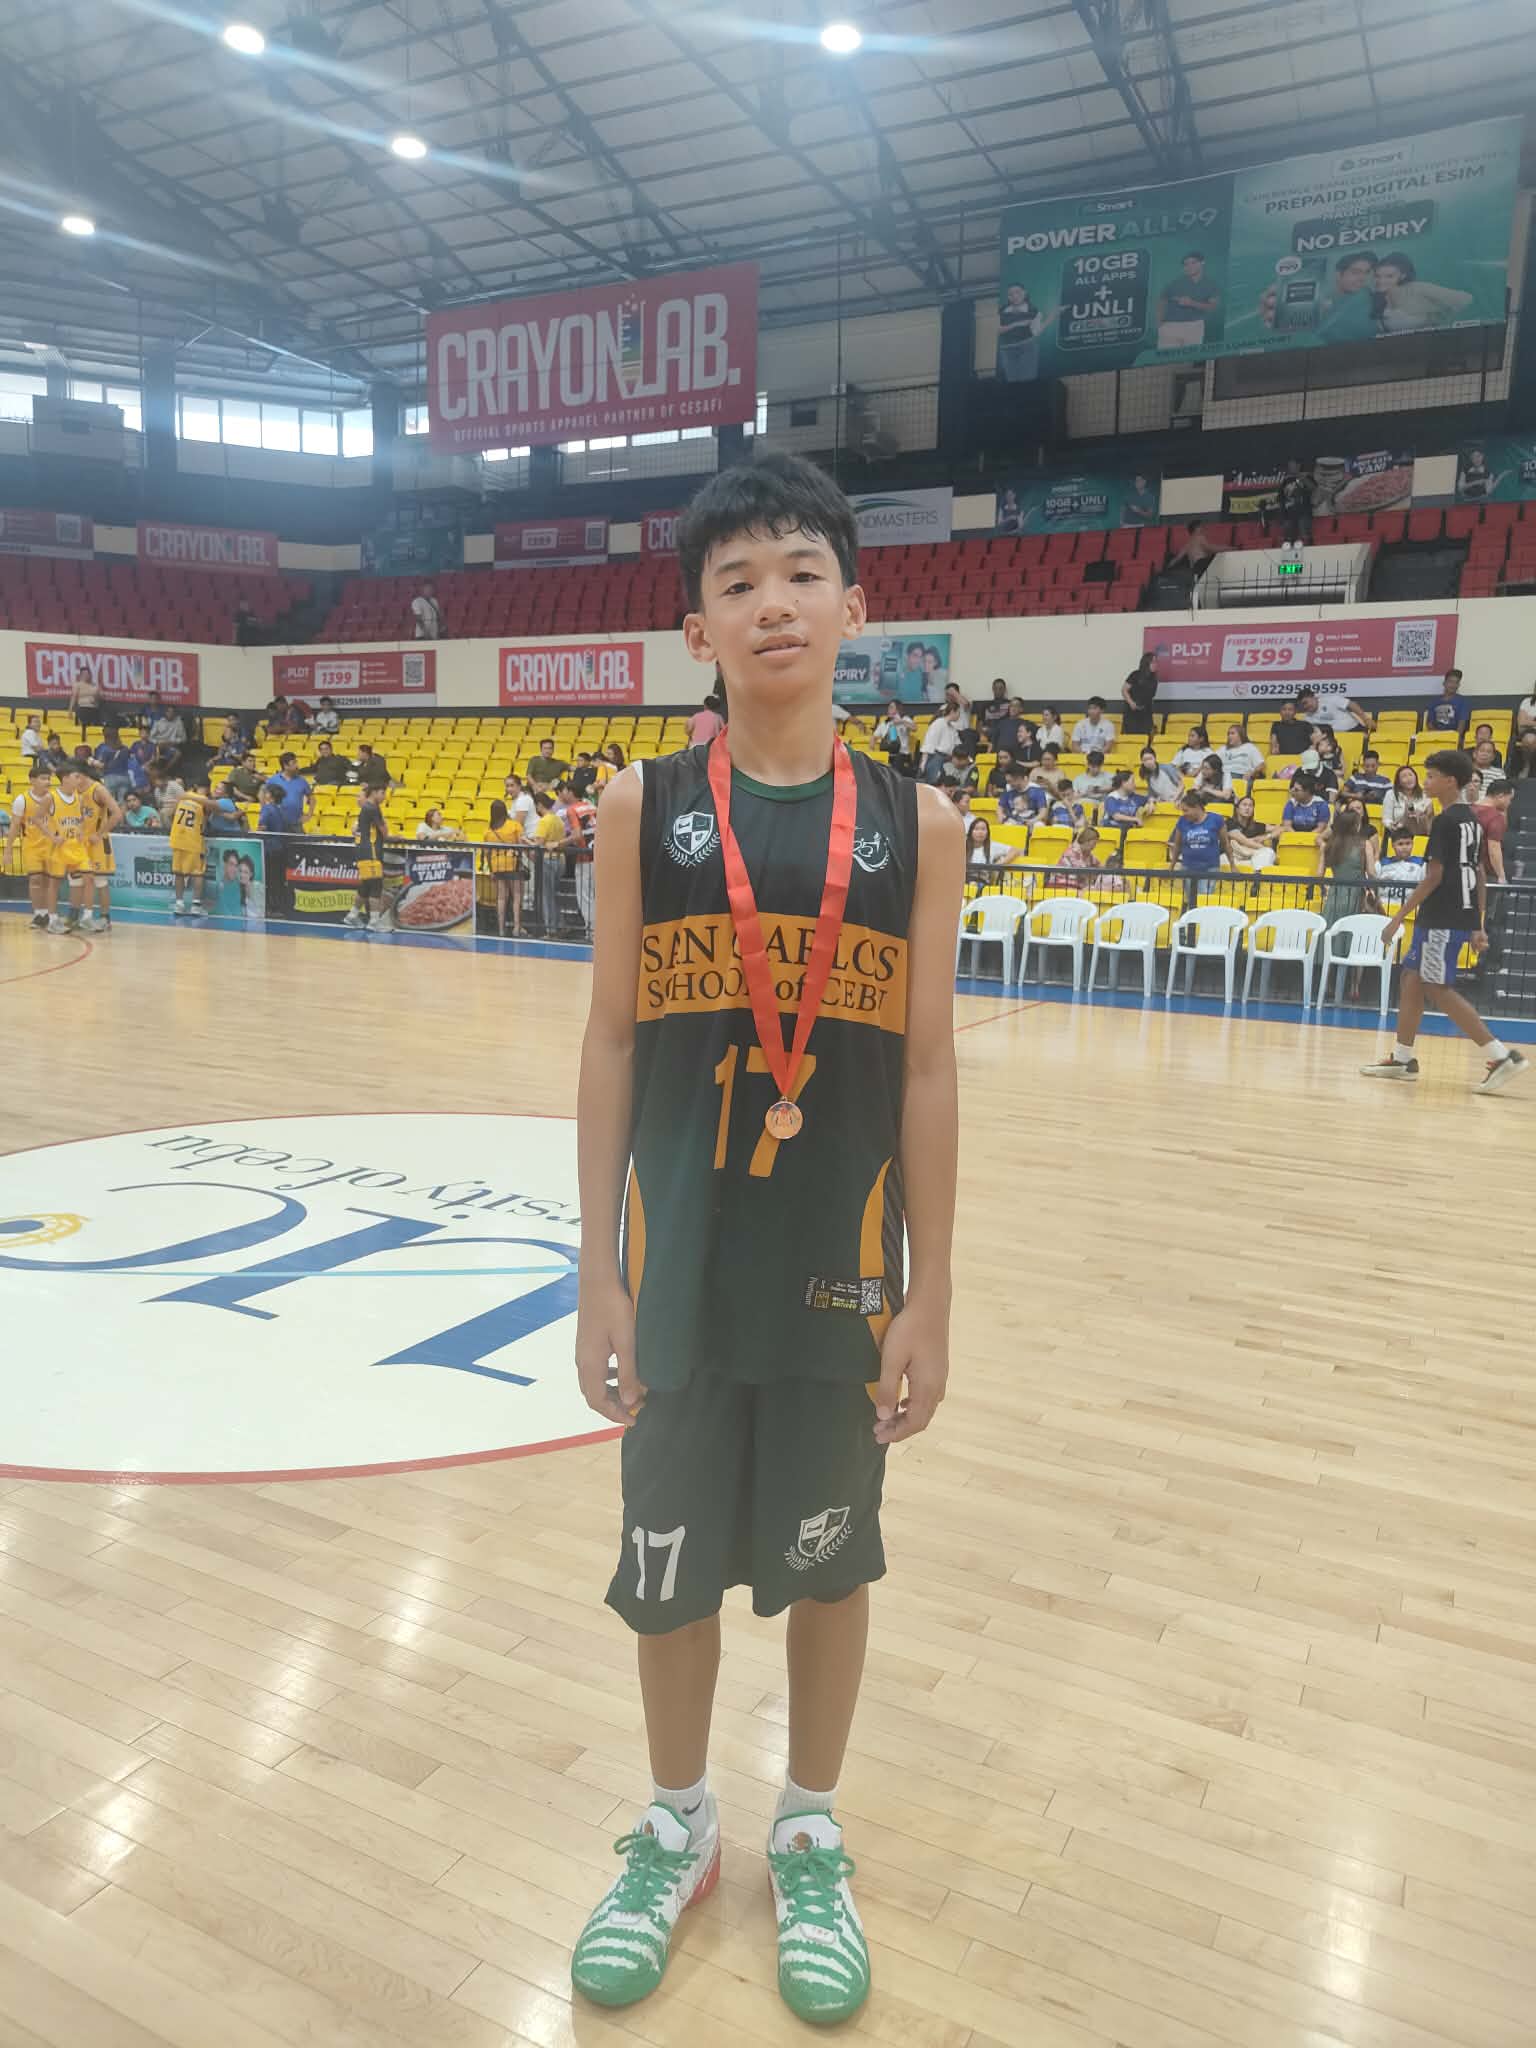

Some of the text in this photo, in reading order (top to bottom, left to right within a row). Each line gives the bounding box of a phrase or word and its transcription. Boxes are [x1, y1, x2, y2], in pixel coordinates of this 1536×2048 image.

[1265, 189, 1347, 215] PREPAID
[1351, 174, 1431, 200] DIGITAL
[1435, 165, 1486, 185] ESIM
[1007, 206, 1218, 256] POWER ALL 99
[1296, 216, 1428, 253] NO EXPIRY
[1073, 251, 1138, 275] 10GB
[1075, 270, 1137, 286] ALL APPS
[1072, 296, 1134, 319] UNLI
[505, 420, 546, 437] SPORTS
[603, 406, 656, 424] PARTNER
[660, 405, 675, 418] OF
[679, 397, 723, 416] CESAFI
[1230, 467, 1286, 488] Australi
[1279, 564, 1304, 575] EXIT
[1171, 642, 1214, 658] PLDT
[1235, 647, 1294, 666] 1399
[321, 671, 353, 686] 1399
[834, 668, 867, 681] XPIRY
[176, 807, 196, 828] 72
[136, 872, 189, 889] NO EXPIY
[643, 924, 900, 983] SAN ALOS
[647, 968, 750, 1009] SHOO
[775, 971, 808, 1002] of
[713, 1044, 817, 1178] 17
[145, 1134, 296, 1172] cebu
[399, 1179, 581, 1228] rsity
[631, 1525, 687, 1602] 17
